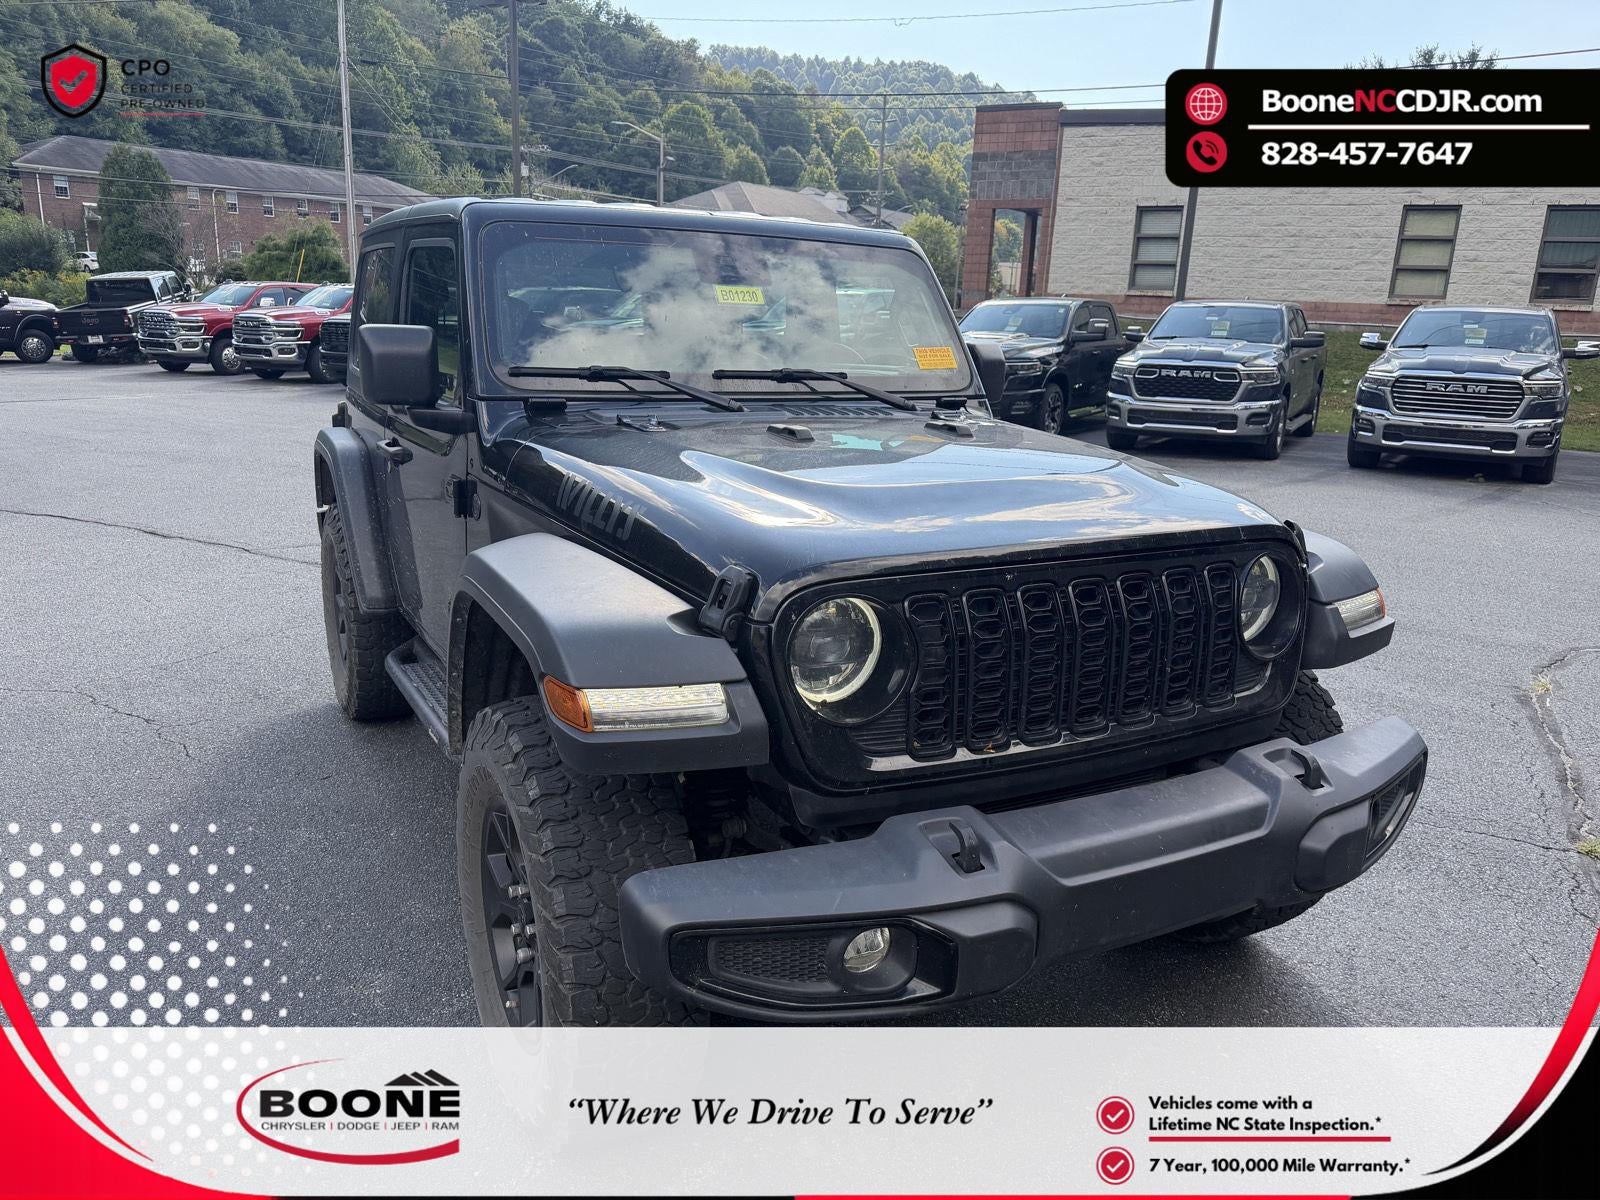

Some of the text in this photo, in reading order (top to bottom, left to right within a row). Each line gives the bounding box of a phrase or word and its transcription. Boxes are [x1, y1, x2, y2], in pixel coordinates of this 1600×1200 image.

[720, 289, 759, 302] B01230
[1160, 368, 1212, 378] RAM
[1425, 382, 1488, 394] RAM
